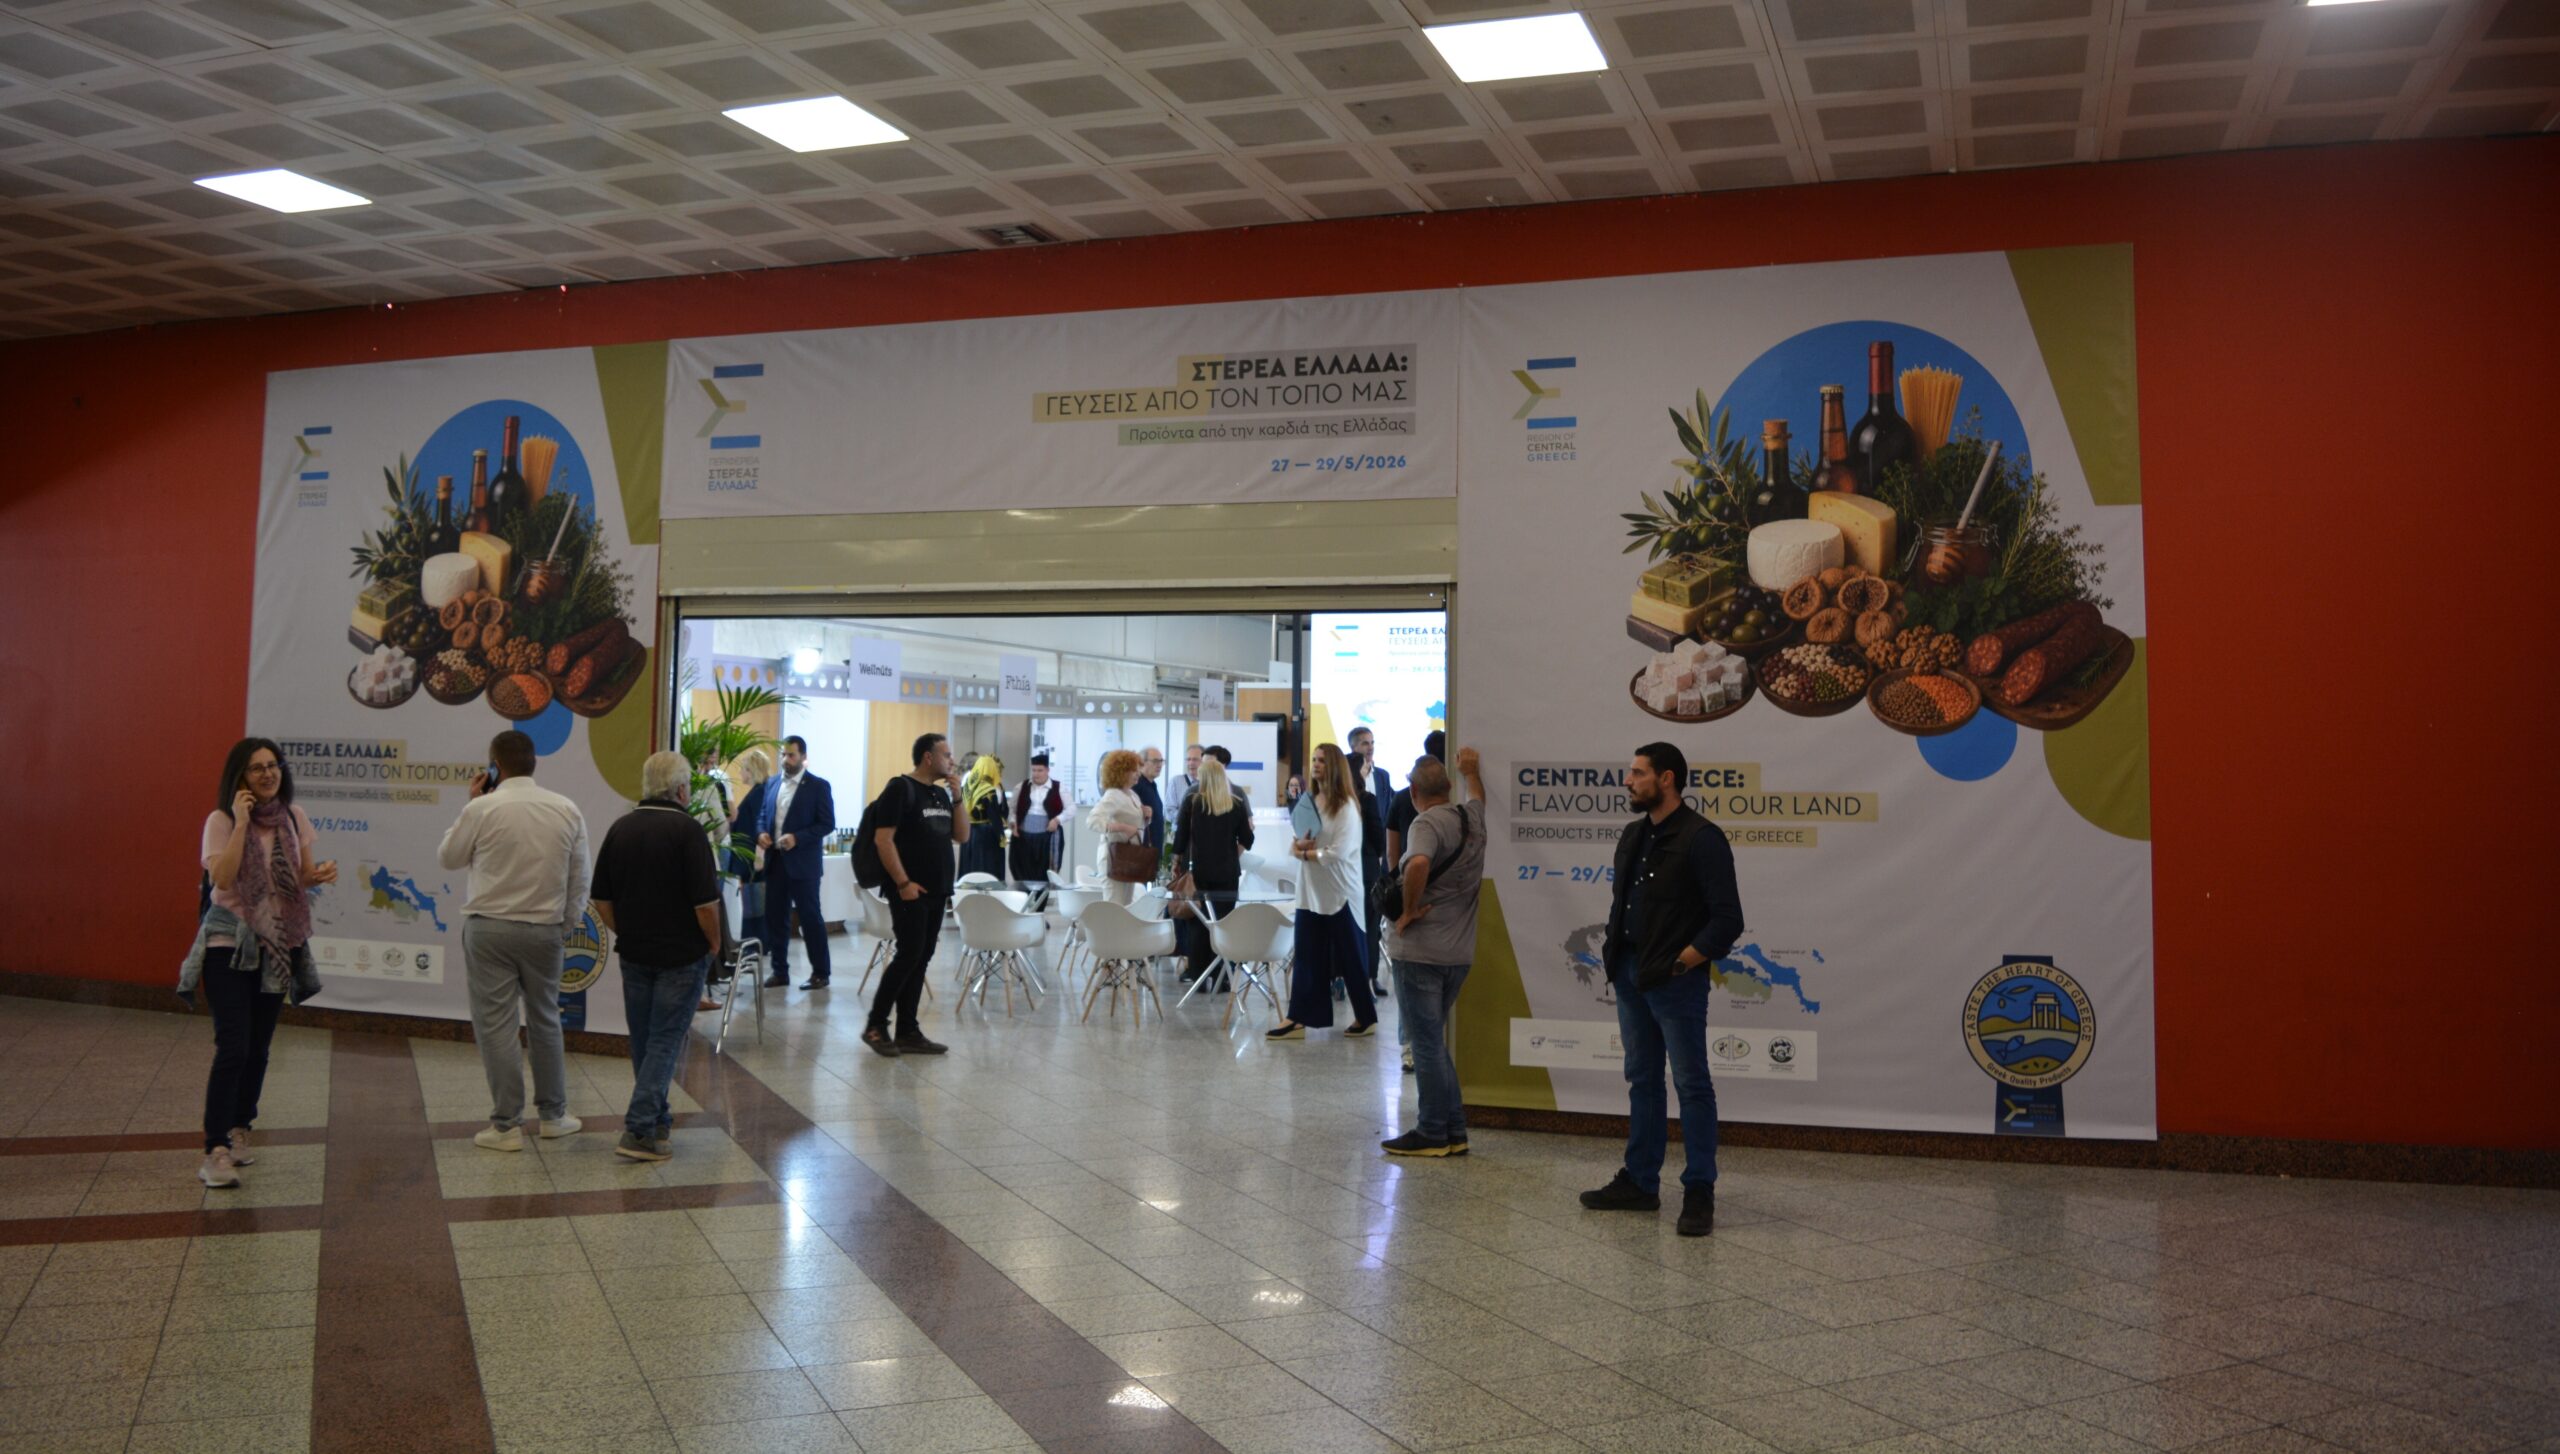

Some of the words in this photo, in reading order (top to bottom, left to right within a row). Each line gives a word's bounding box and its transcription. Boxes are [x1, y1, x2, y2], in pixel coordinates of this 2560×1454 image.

[1192, 359, 1286, 381] ΣΤΕΡΕΑ
[1295, 352, 1408, 376] ΕΛΛΑΔΑ:
[1047, 393, 1137, 416] ΓΕΥΣΕΙΣ
[1145, 388, 1198, 412] ΑΠΟ
[1206, 386, 1258, 409] ΤΟΝ
[1267, 383, 1342, 406] ΤΟΠΟ
[1352, 380, 1407, 402] ΜΑΣ
[1129, 425, 1194, 443] Προϊόντα
[1199, 423, 1225, 441] από
[1230, 424, 1255, 440] την
[1258, 420, 1309, 440] καρδιά
[1314, 421, 1338, 437] της
[1343, 417, 1408, 435] Ελλάδας
[1527, 433, 1561, 442] REGION
[1563, 432, 1576, 441] OF
[1527, 442, 1576, 451] CENTRAL
[1271, 458, 1289, 472] 27
[1316, 453, 1407, 474] 29/5/2026
[1527, 452, 1577, 462] GREECE
[708, 467, 760, 479] ΣΤΕΡΕΑΣ
[708, 480, 759, 491] ΕΛΛΑΔΑΣ
[1389, 627, 1428, 635] ΣΤΕΡΕΑ
[280, 742, 331, 757] ΣΤΕΡΕΑ
[335, 744, 397, 759] ΕΛΛΑΔΑ:
[287, 761, 332, 777] ΕΥΣΕΙΣ
[335, 763, 367, 778] ΑΠΟ
[370, 764, 402, 779] ΤΟΝ
[406, 765, 449, 781] ΤΟΠΟ
[1518, 768, 1628, 787] CENTRAL
[1689, 769, 1744, 788] ECE:
[1729, 796, 1783, 815] OUR
[1793, 797, 1861, 816] LAND
[1518, 827, 1592, 839] PRODUCTS
[1597, 828, 1624, 841] FRO
[1746, 831, 1803, 843] GREECE
[1518, 865, 1539, 880] 27
[1967, 995, 1982, 1039] TASTE
[1979, 972, 2002, 996] THE
[2004, 965, 2053, 979] HEART
[2055, 975, 2071, 989] OF
[2071, 988, 2092, 1042] GREECE
[1986, 1062, 2008, 1080] Greek
[2009, 1074, 2037, 1087] Quality
[2039, 1067, 2072, 1085] Products
